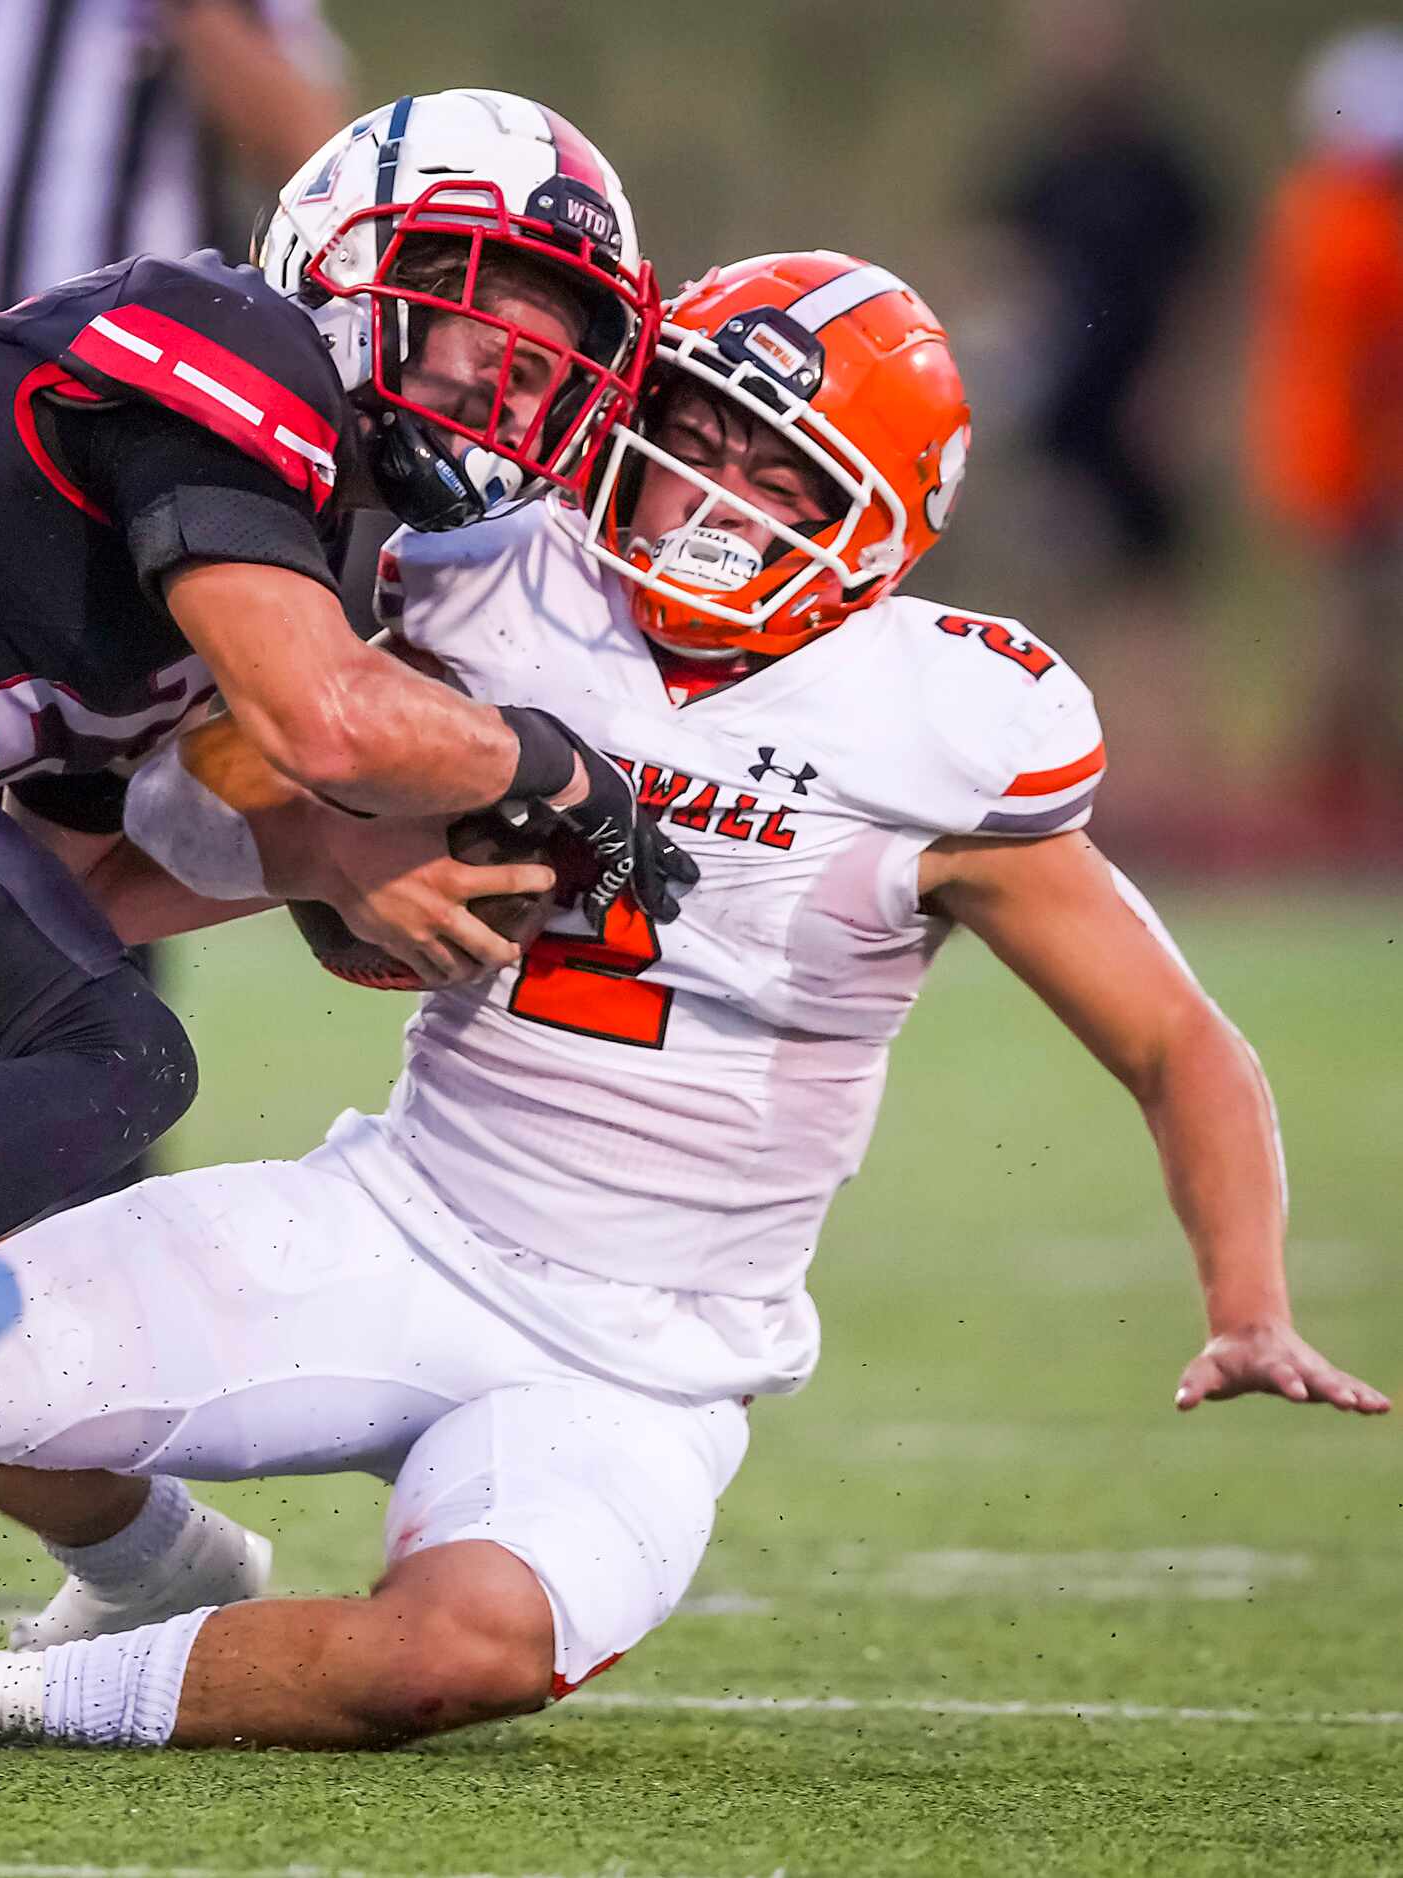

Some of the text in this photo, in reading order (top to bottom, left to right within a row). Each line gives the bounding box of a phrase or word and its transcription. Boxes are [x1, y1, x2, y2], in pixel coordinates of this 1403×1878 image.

[566, 198, 607, 236] WTD
[935, 615, 1057, 682] 2
[508, 890, 675, 1051] 2
